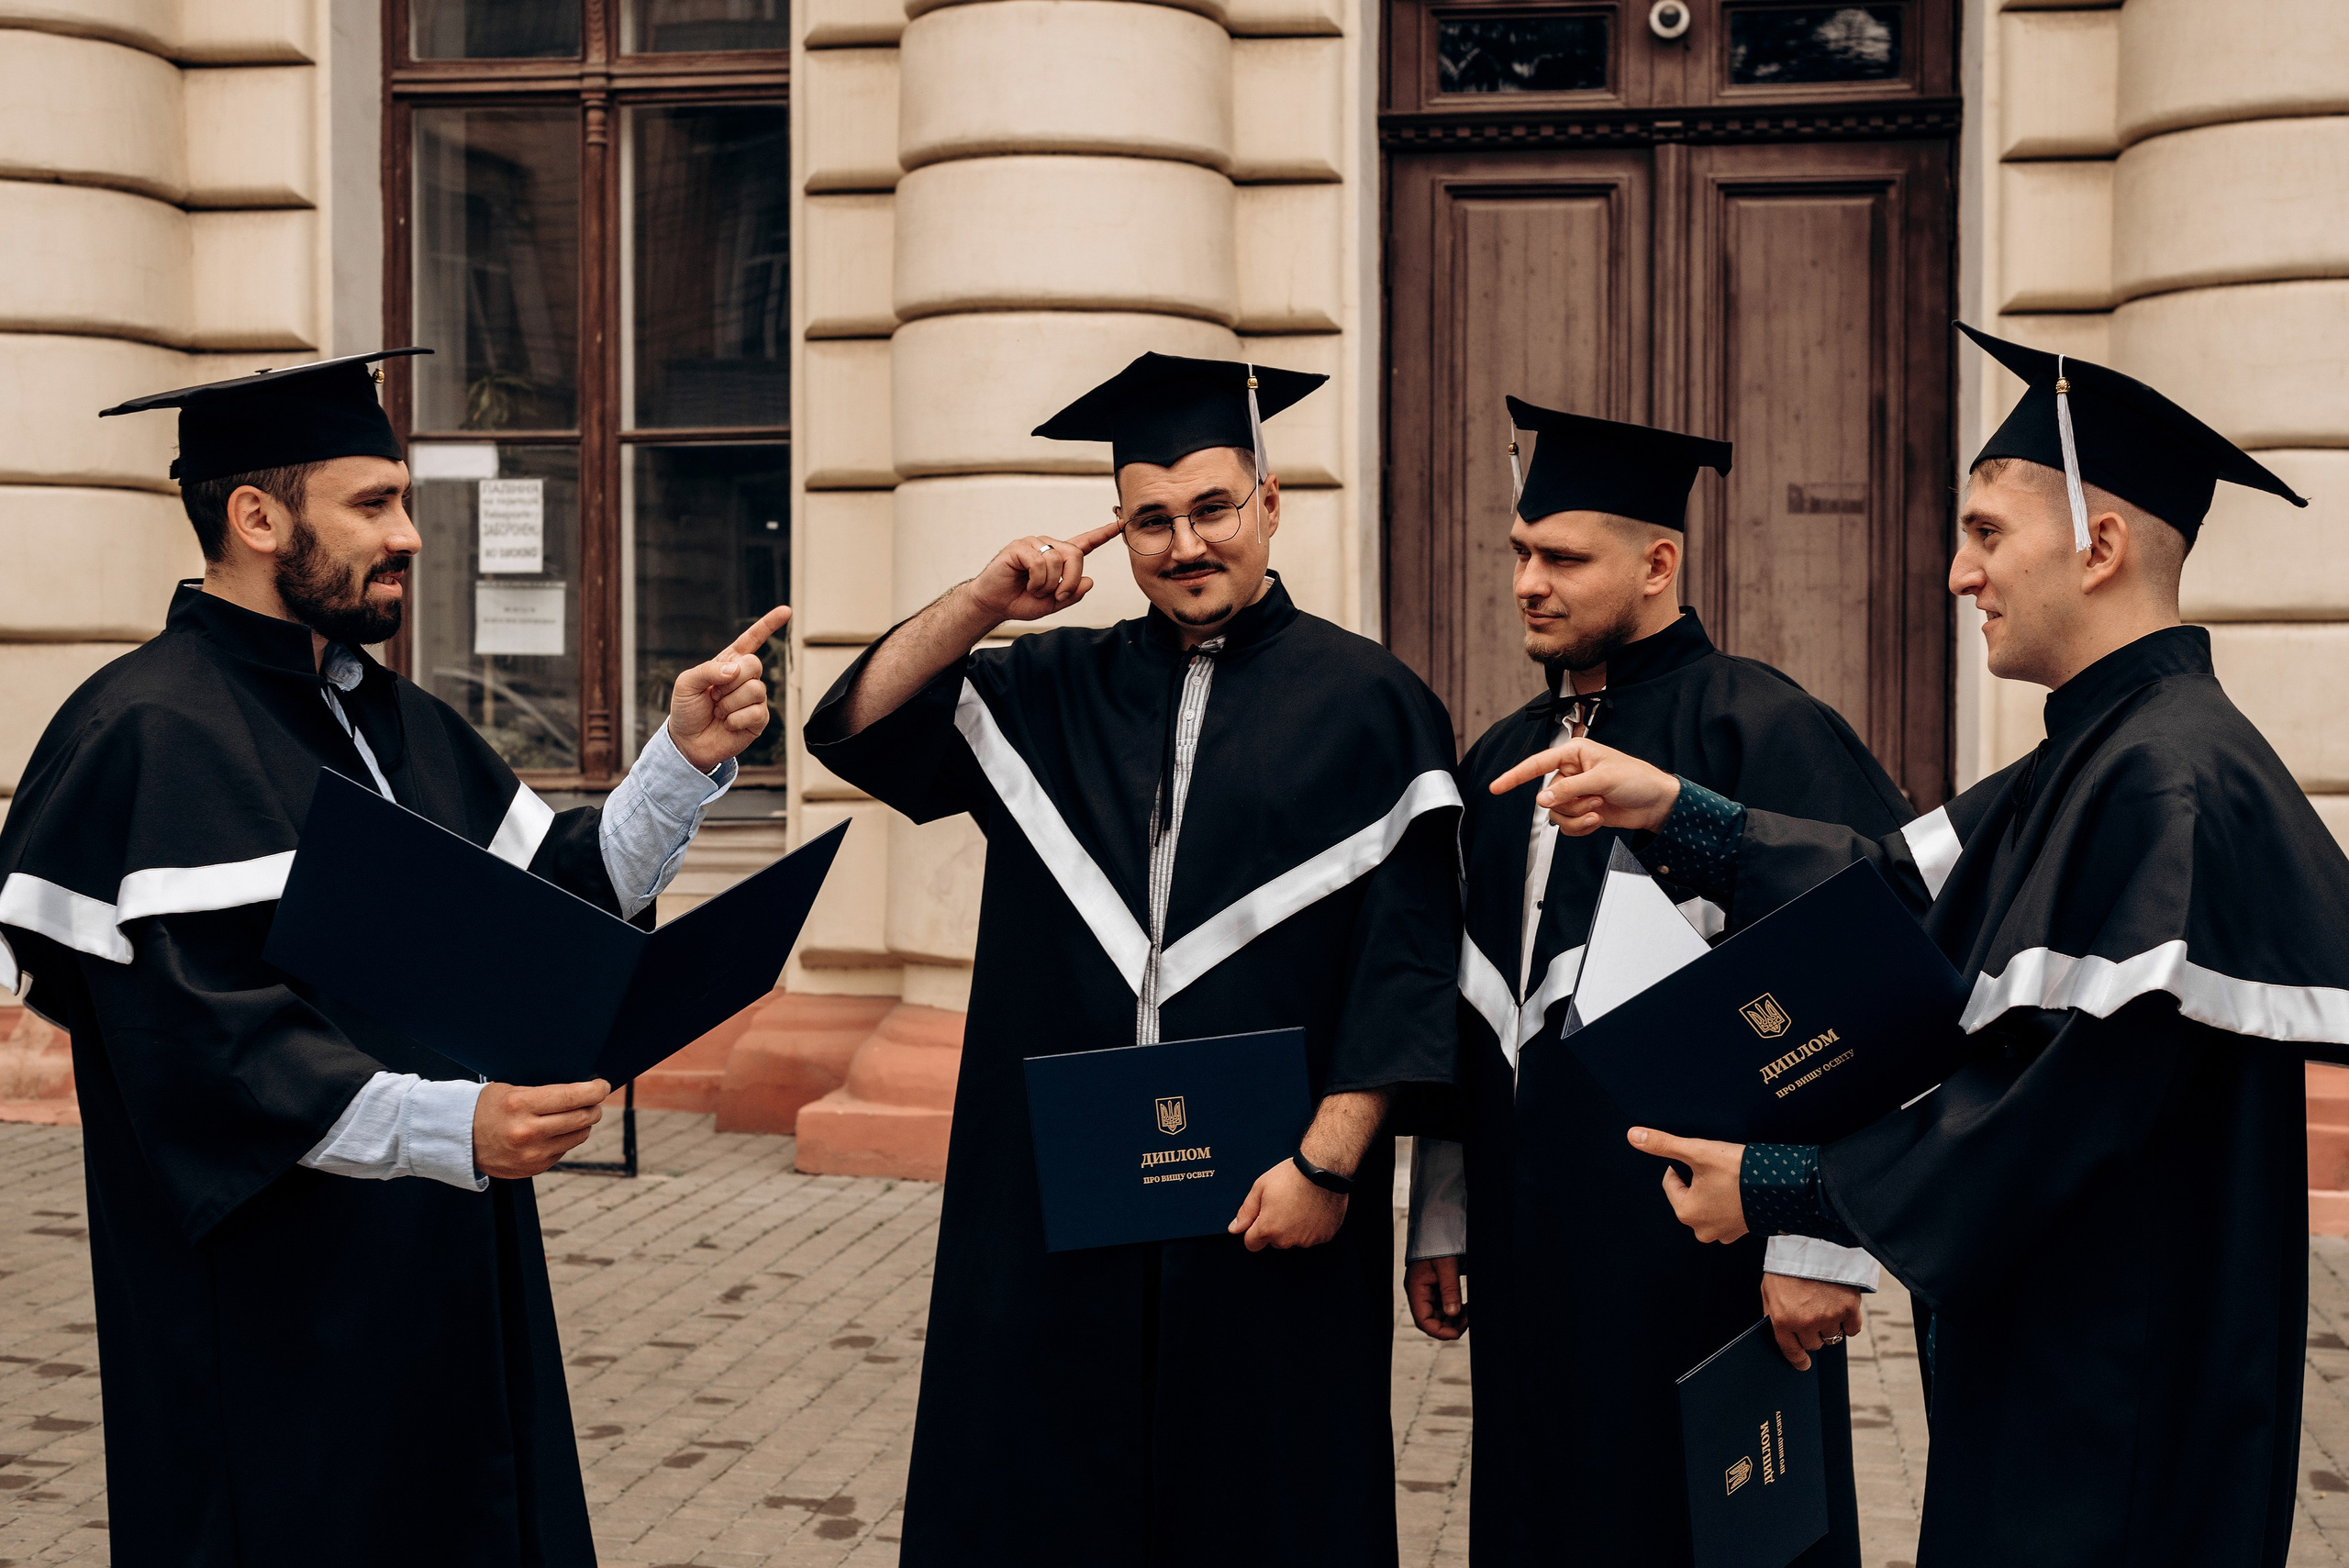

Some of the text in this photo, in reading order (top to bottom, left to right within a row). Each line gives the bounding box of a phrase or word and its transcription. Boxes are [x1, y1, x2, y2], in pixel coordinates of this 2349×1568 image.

[1759, 1028, 1841, 1084] ДИПЛОМ
[1775, 1049, 1854, 1099] ПРО ВИЩУ ОСВІТУ
[1141, 1146, 1212, 1169] ДИПЛОМ
[1142, 1169, 1216, 1184] ПРО ВИЩУ ОСВІТУ
[1759, 1419, 1776, 1485] ДИПЛОМ
